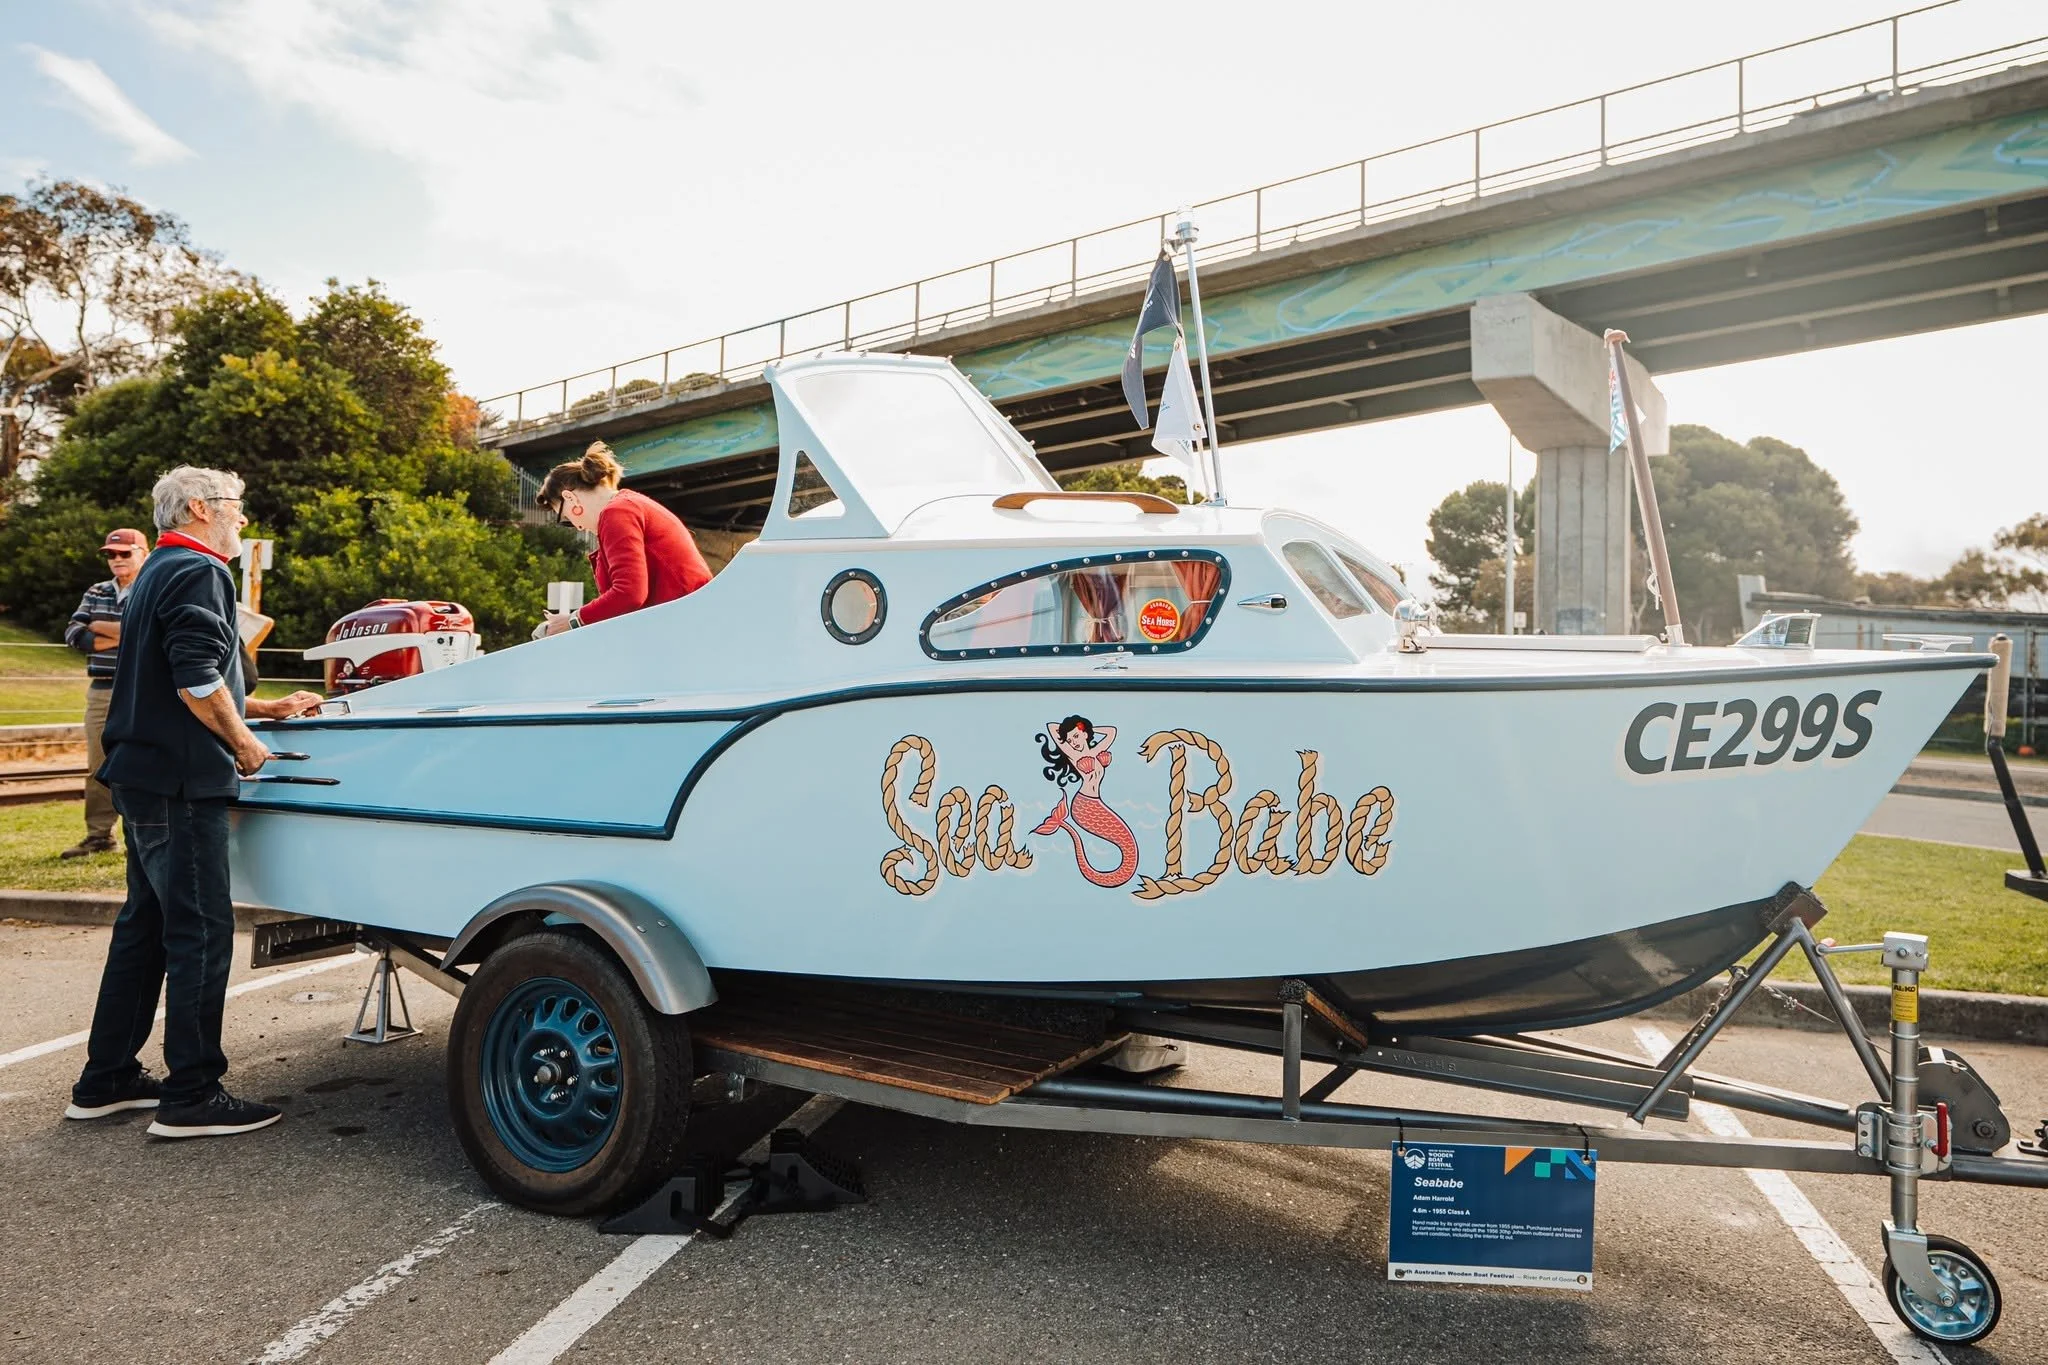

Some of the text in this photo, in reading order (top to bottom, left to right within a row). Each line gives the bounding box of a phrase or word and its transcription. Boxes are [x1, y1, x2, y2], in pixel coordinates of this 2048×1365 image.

[336, 620, 389, 642] Johnson
[1141, 615, 1176, 628] SEA HORSE
[1624, 689, 1883, 775] CE299S
[879, 728, 1395, 900] Sea Babe
[1414, 1177, 1463, 1188] Seababe
